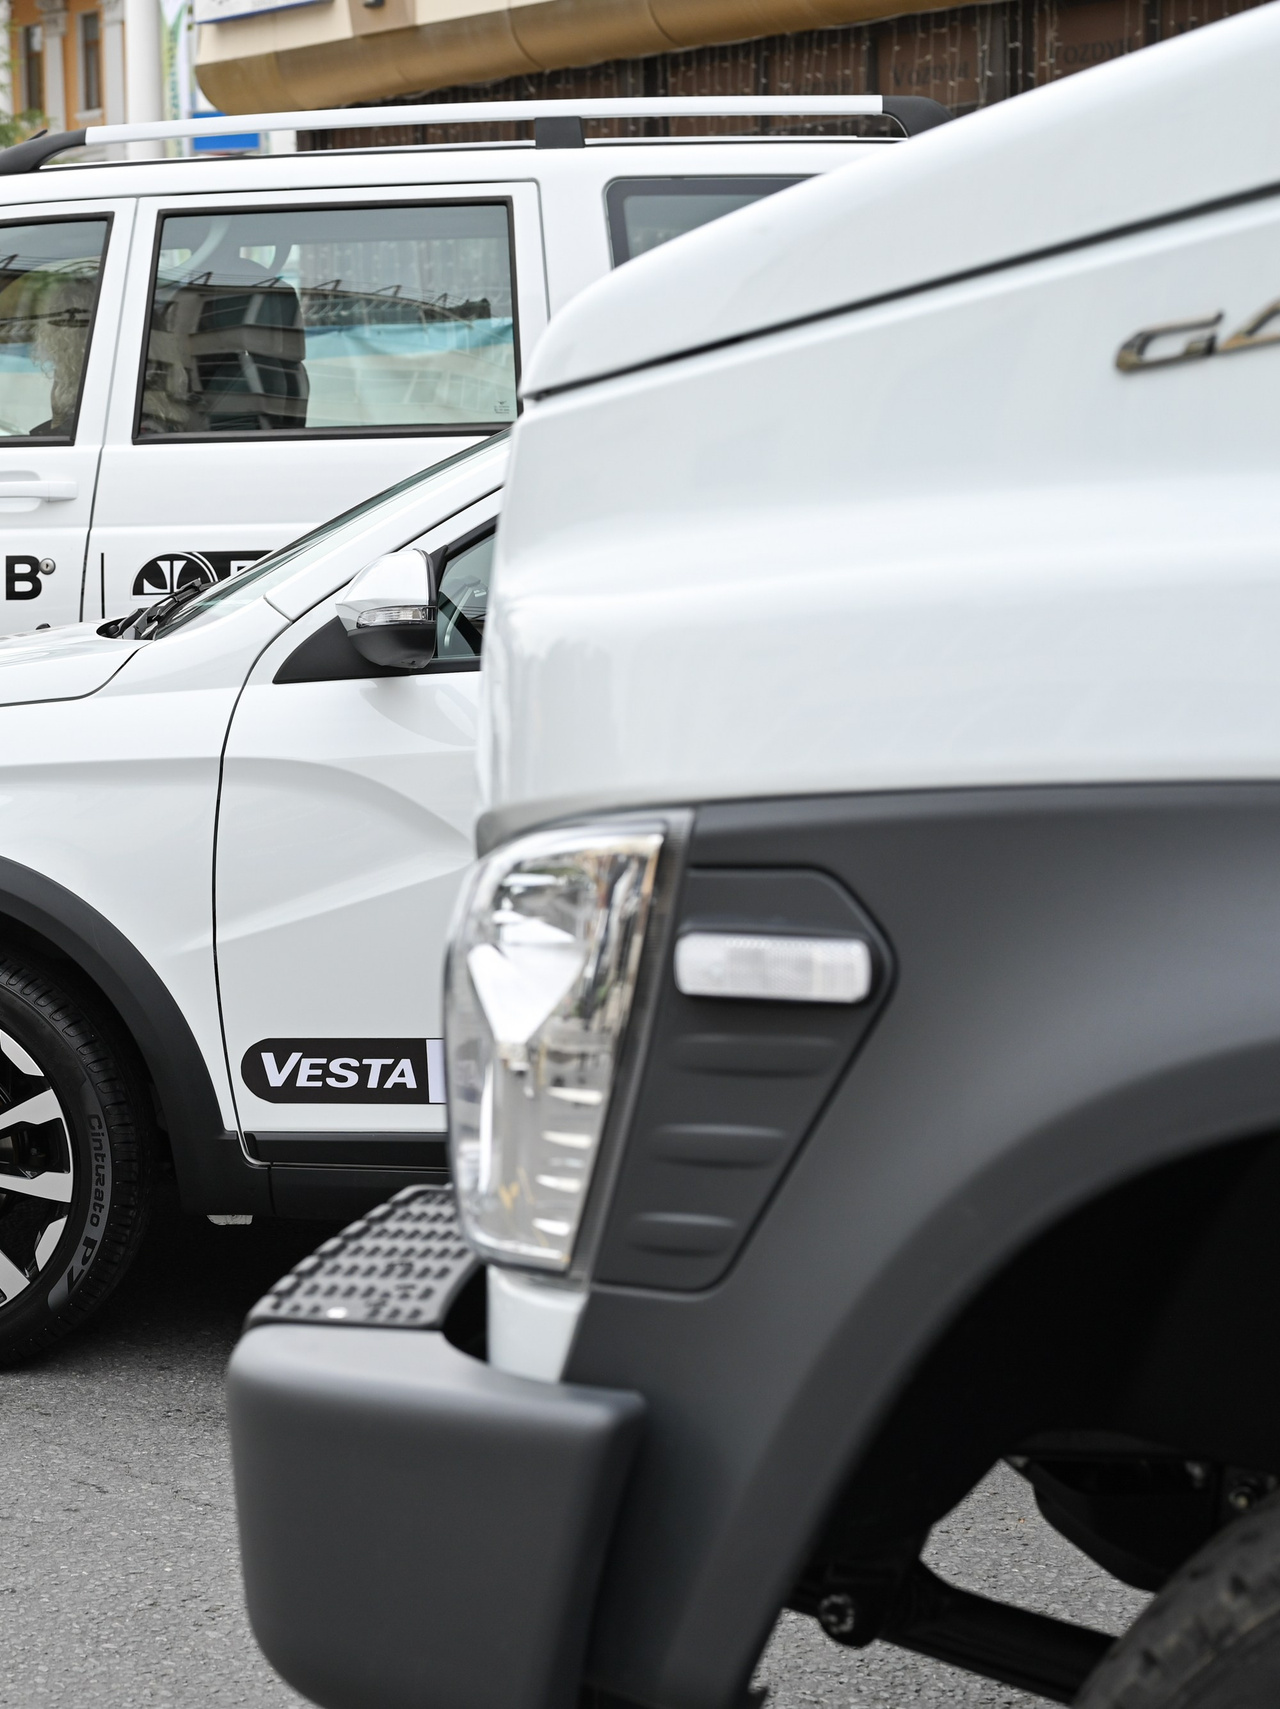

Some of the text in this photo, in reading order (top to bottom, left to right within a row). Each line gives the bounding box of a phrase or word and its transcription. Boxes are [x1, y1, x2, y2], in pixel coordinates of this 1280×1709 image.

[261, 1052, 417, 1089] VESTA
[66, 1114, 105, 1296] Cinturato P7
